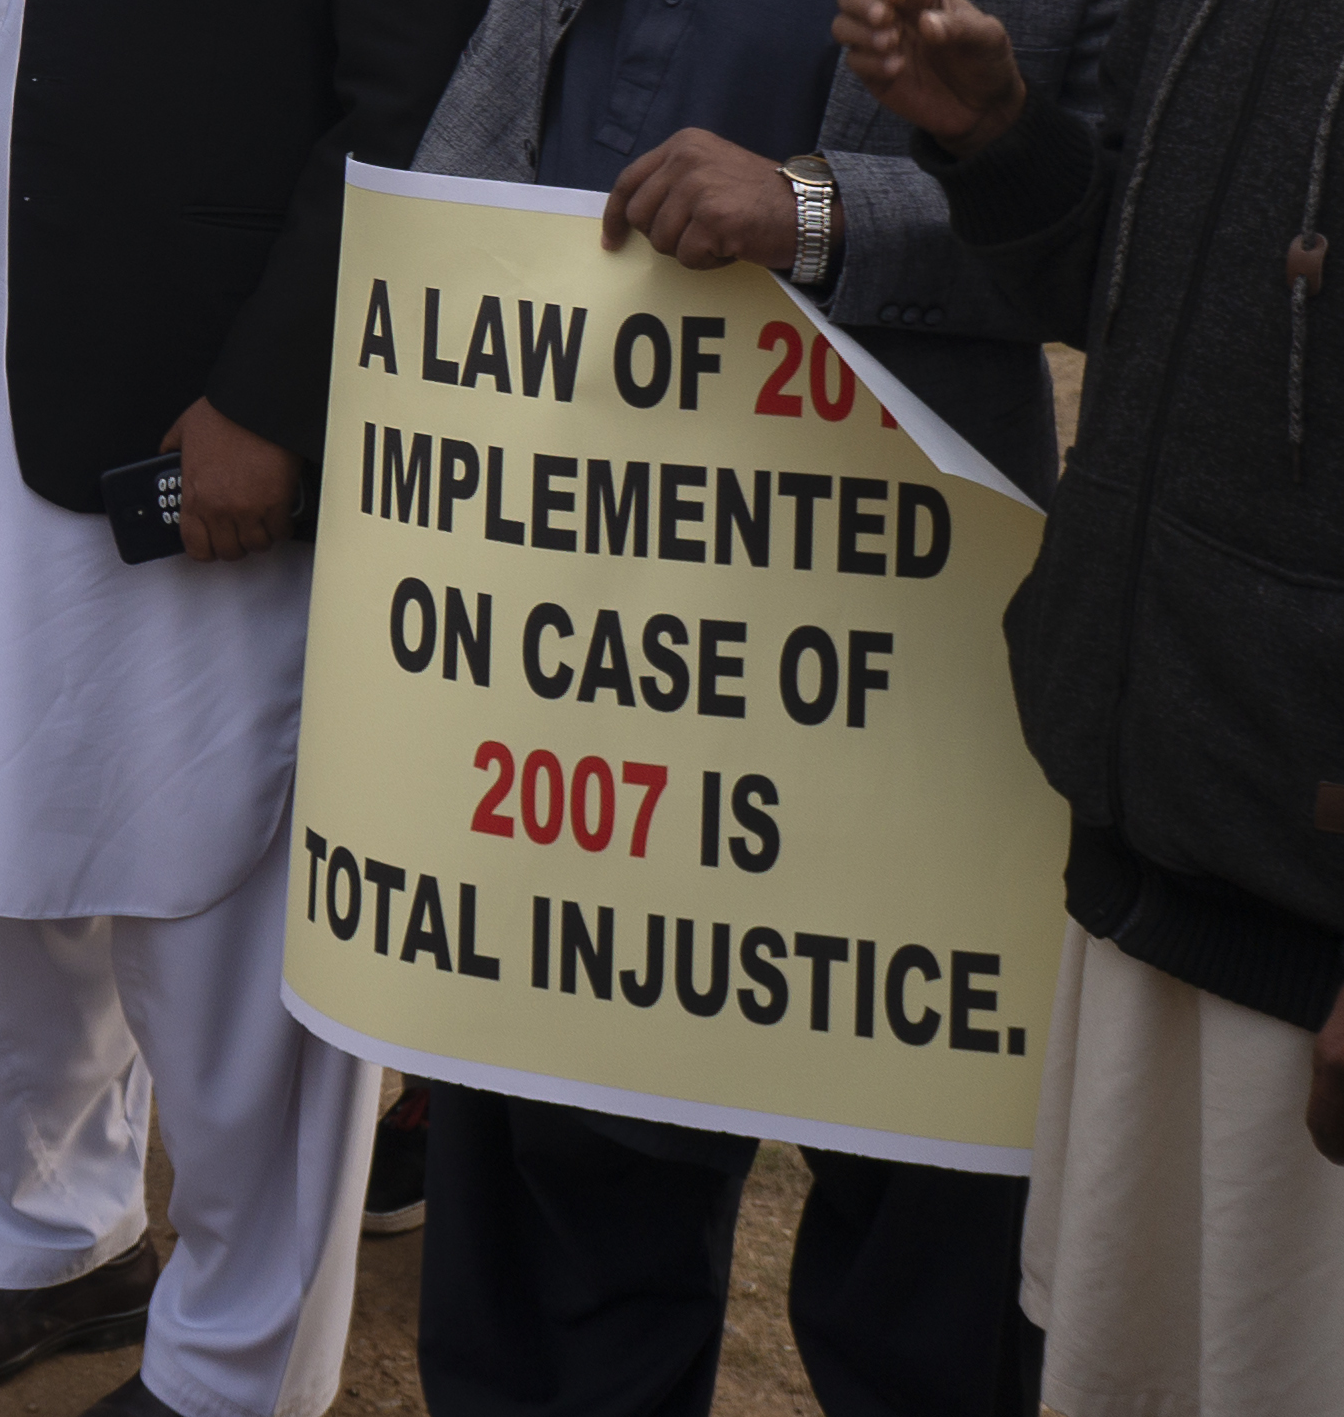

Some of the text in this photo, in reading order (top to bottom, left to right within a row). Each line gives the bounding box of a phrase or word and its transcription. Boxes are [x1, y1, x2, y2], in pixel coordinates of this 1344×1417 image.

[357, 278, 899, 431] A LAW OF 20
[360, 420, 953, 581] IMPLEMENTED
[389, 576, 894, 729] ON CASE OF
[469, 740, 781, 874] 2007 IS
[303, 826, 1027, 1057] TOTAL INJUSTICE.
